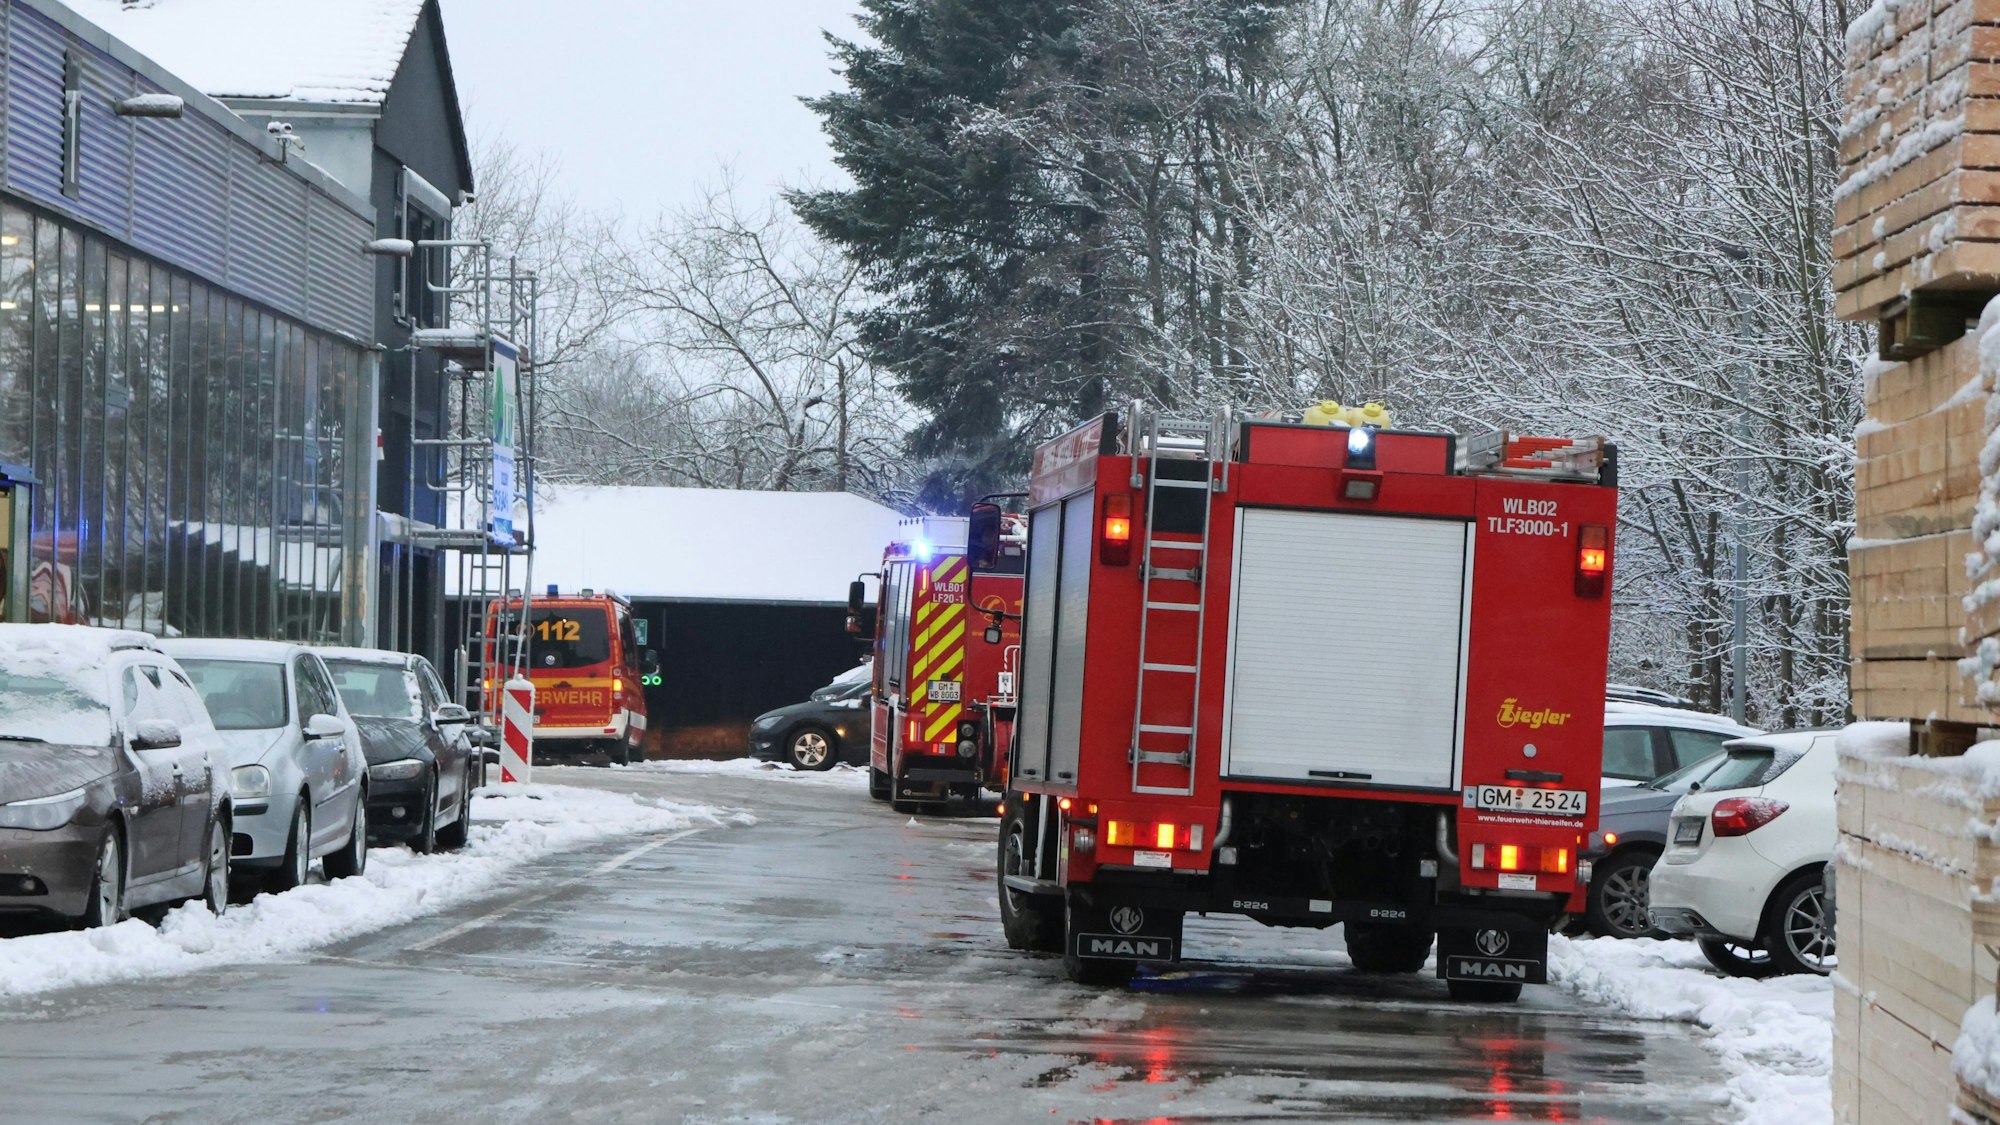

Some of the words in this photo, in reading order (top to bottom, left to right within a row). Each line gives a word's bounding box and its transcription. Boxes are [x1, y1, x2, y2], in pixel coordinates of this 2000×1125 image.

[1503, 498, 1557, 516] WLB02
[1488, 517, 1568, 537] TLF3000-1
[934, 582, 964, 592] WLB01
[537, 621, 580, 641] 112
[1497, 698, 1571, 729] Ziegler
[1532, 791, 1581, 811] 2524
[1478, 815, 1584, 828] www.feuerwehr-thierseifen.de
[1091, 939, 1158, 955] MAN
[1461, 961, 1526, 978] MAN
